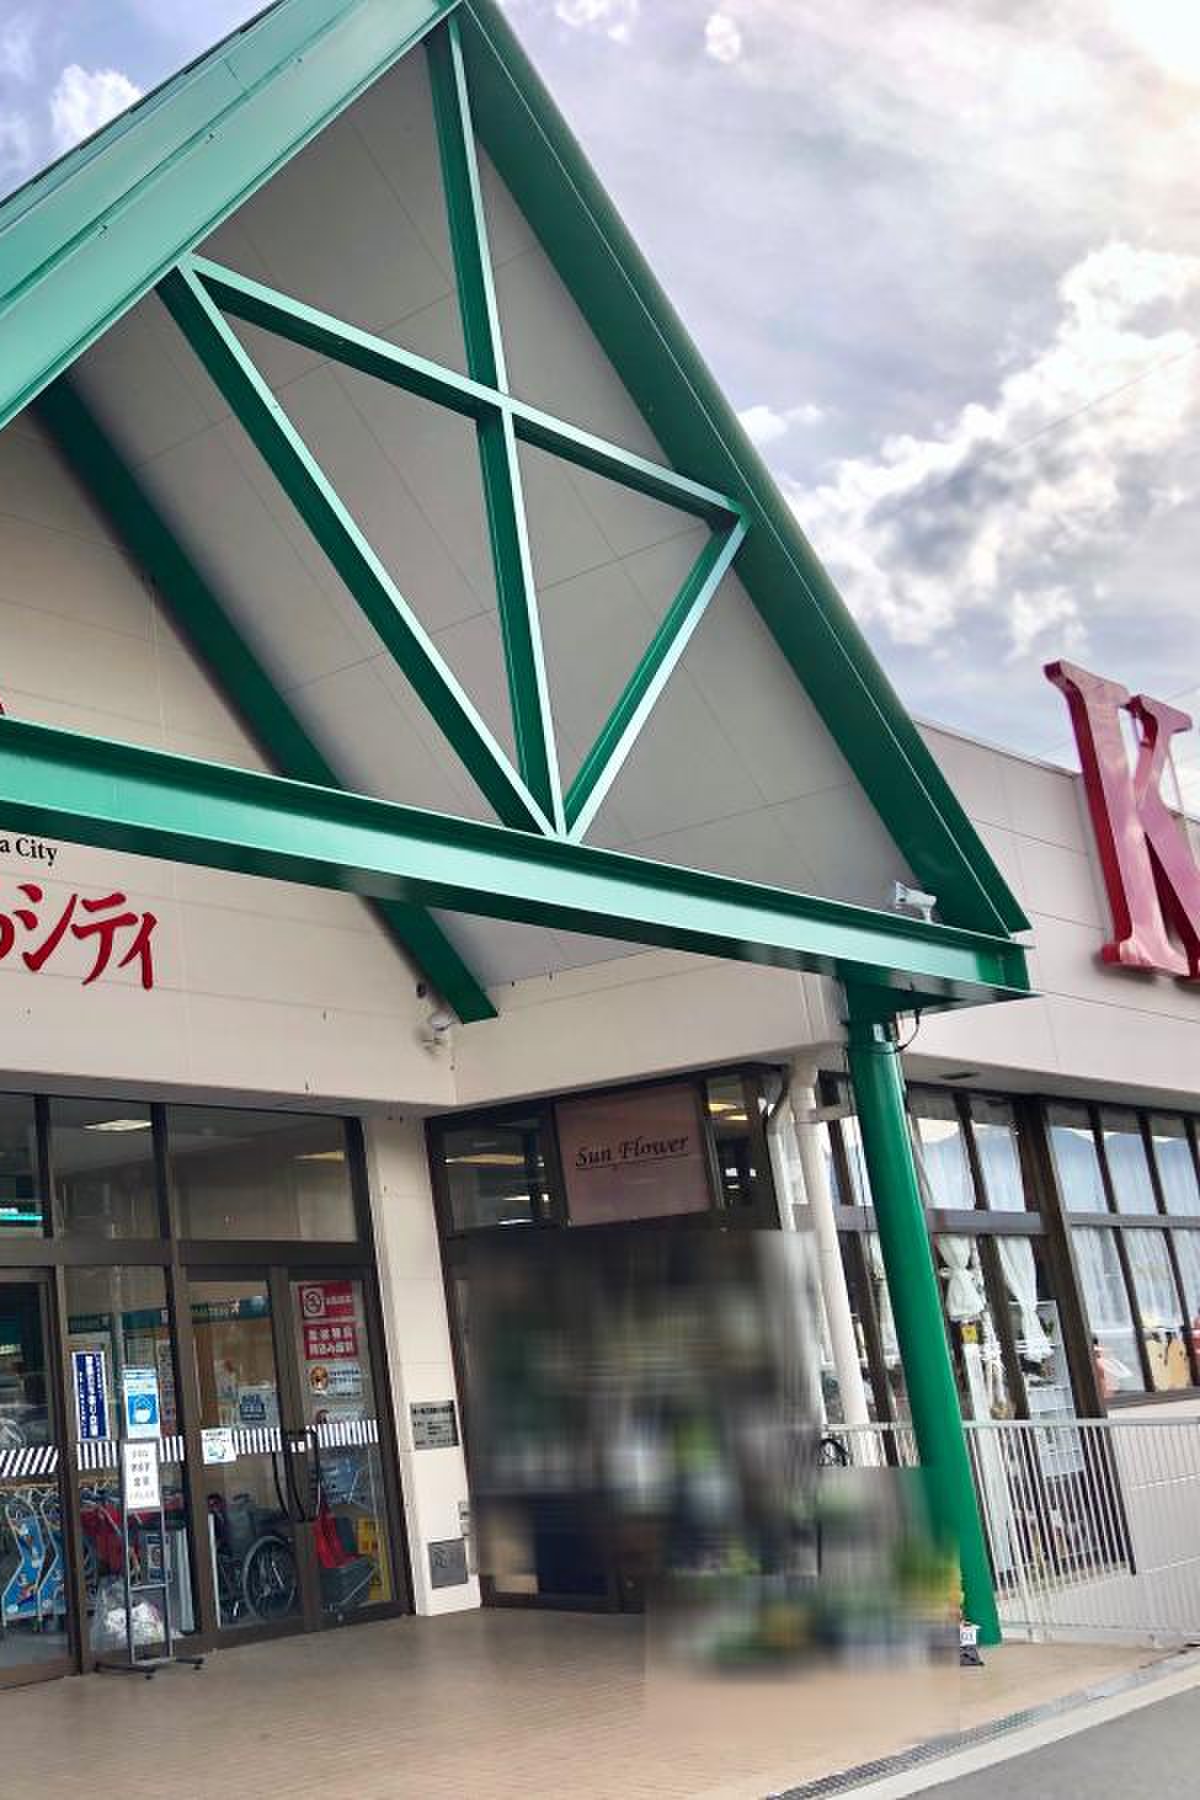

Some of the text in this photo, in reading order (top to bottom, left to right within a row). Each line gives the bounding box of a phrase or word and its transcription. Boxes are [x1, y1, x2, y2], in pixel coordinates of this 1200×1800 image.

[15, 837, 57, 867] City
[576, 1136, 689, 1168] Sun Flower
